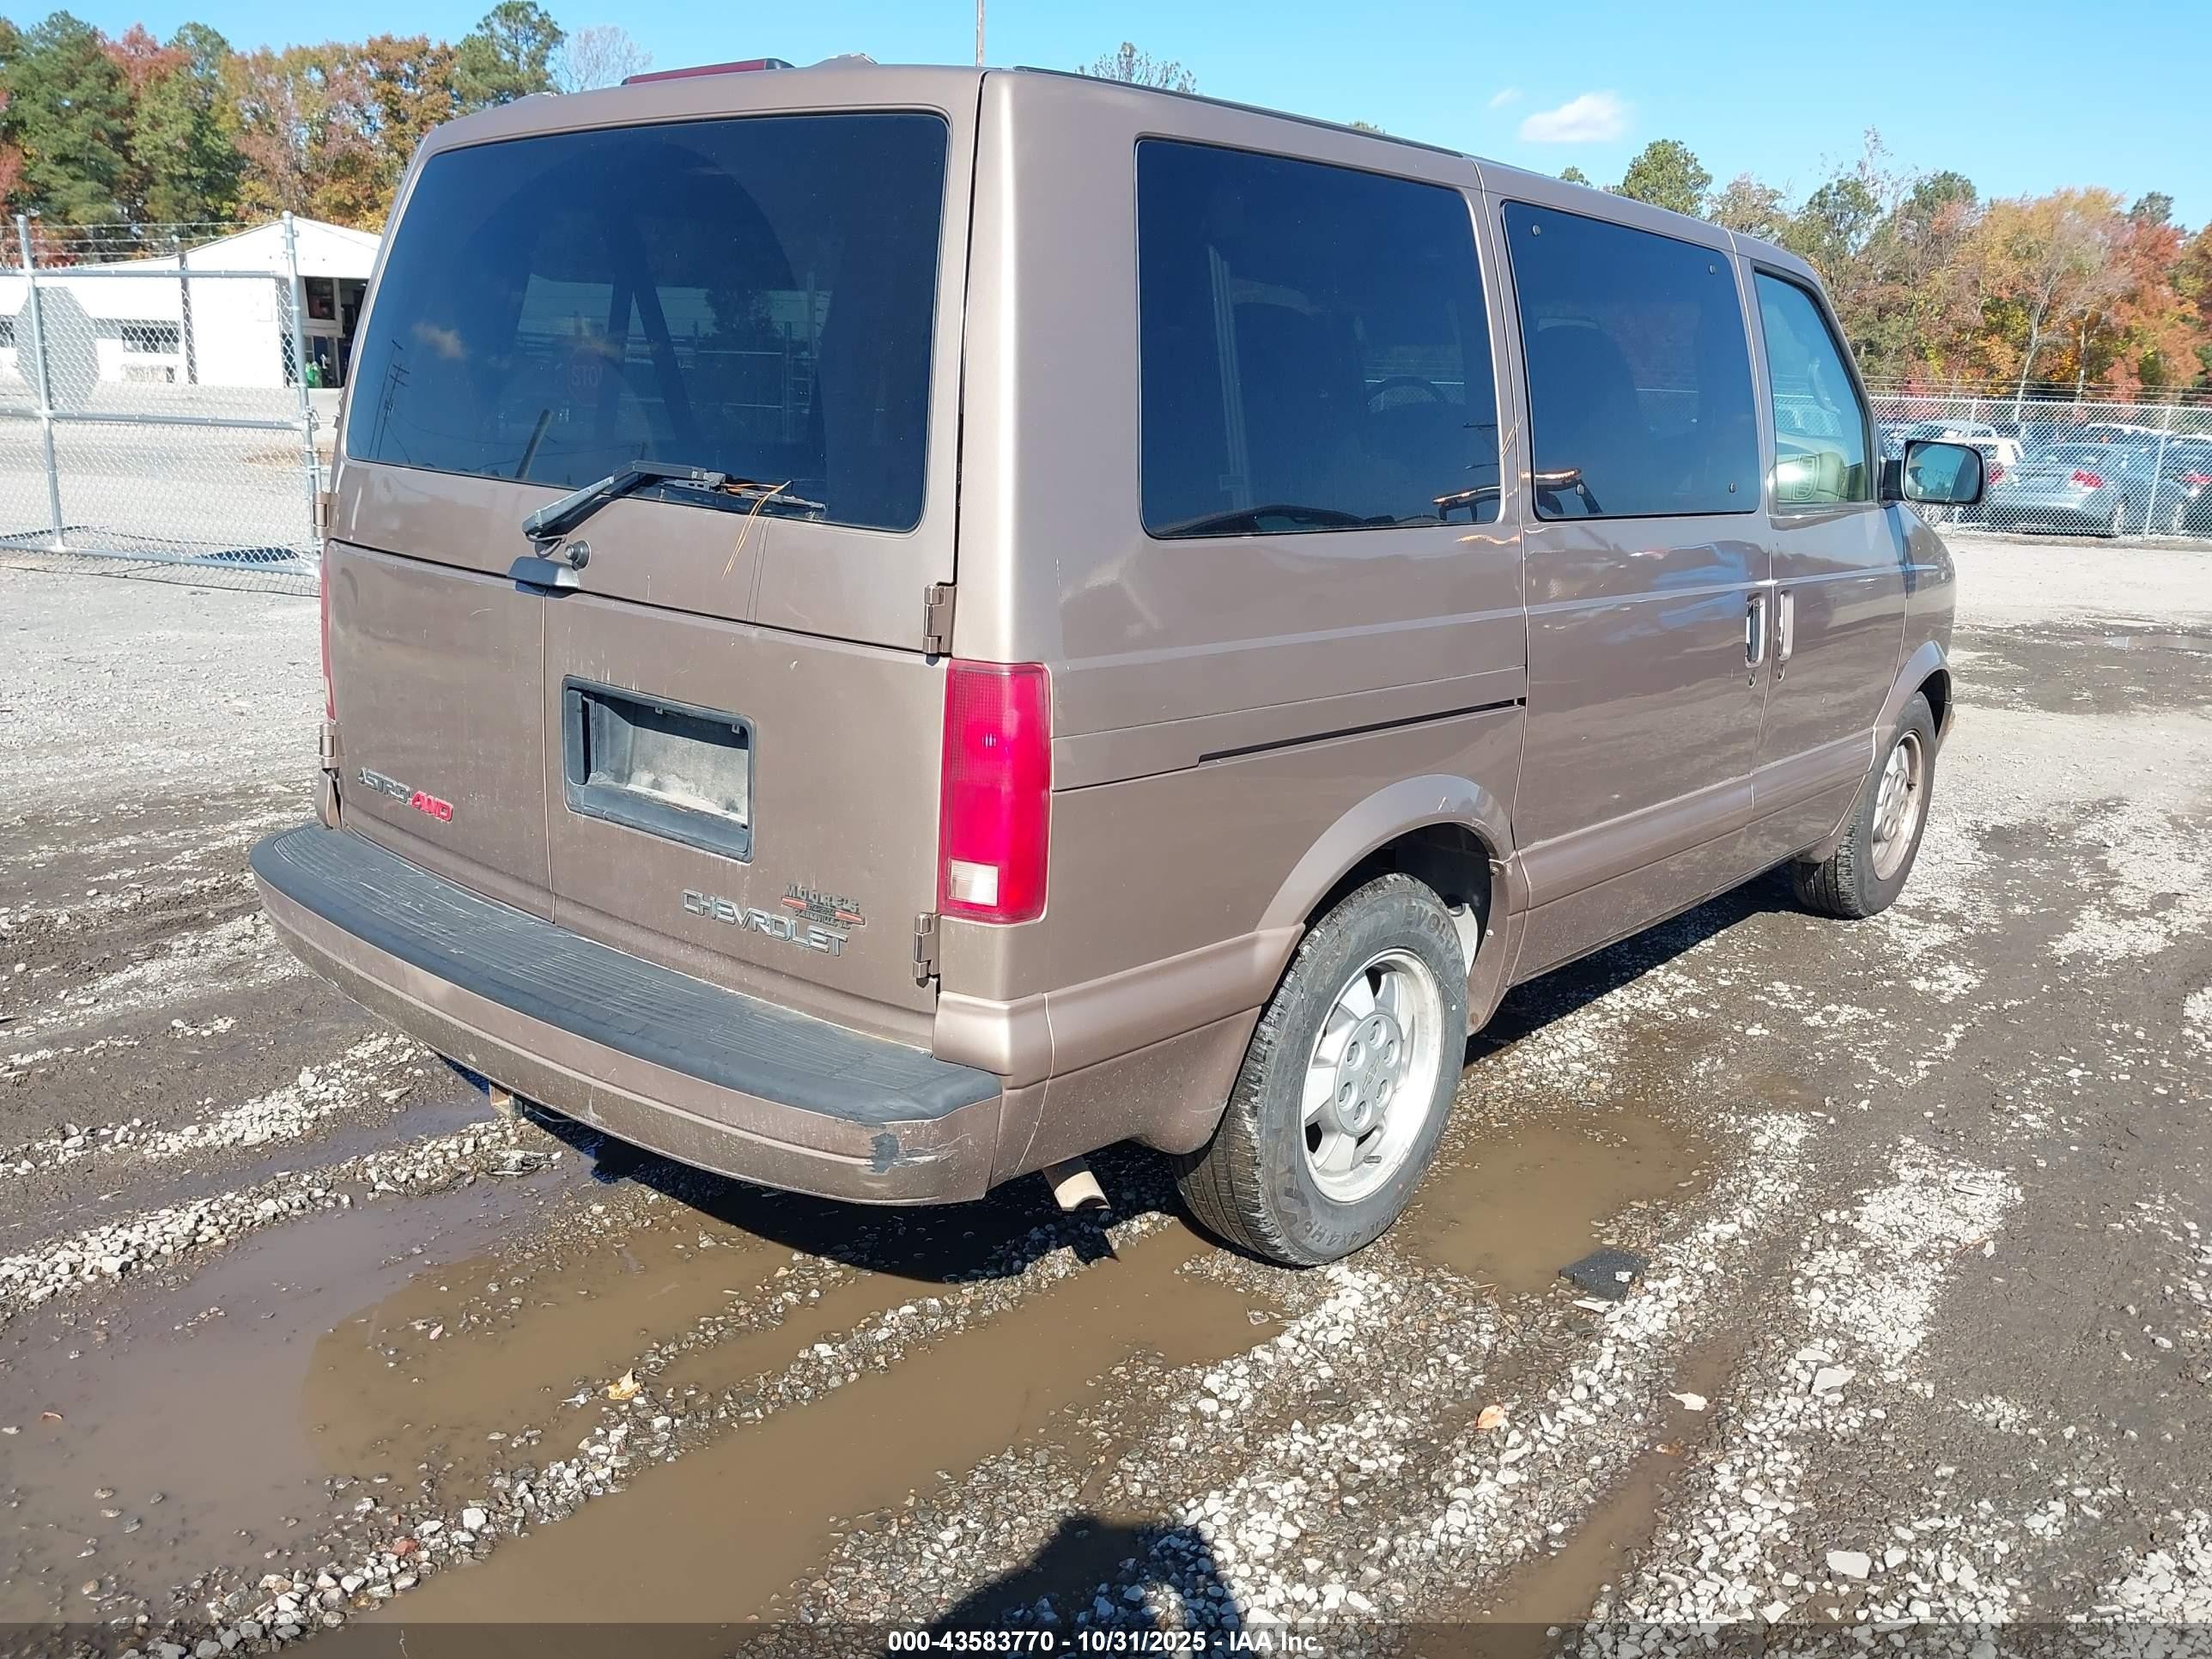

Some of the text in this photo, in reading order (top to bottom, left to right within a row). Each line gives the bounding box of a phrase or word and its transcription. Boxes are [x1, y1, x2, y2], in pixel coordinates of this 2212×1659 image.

[357, 767, 454, 823] ASTRO AWD
[682, 888, 848, 957] CHEVROLET
